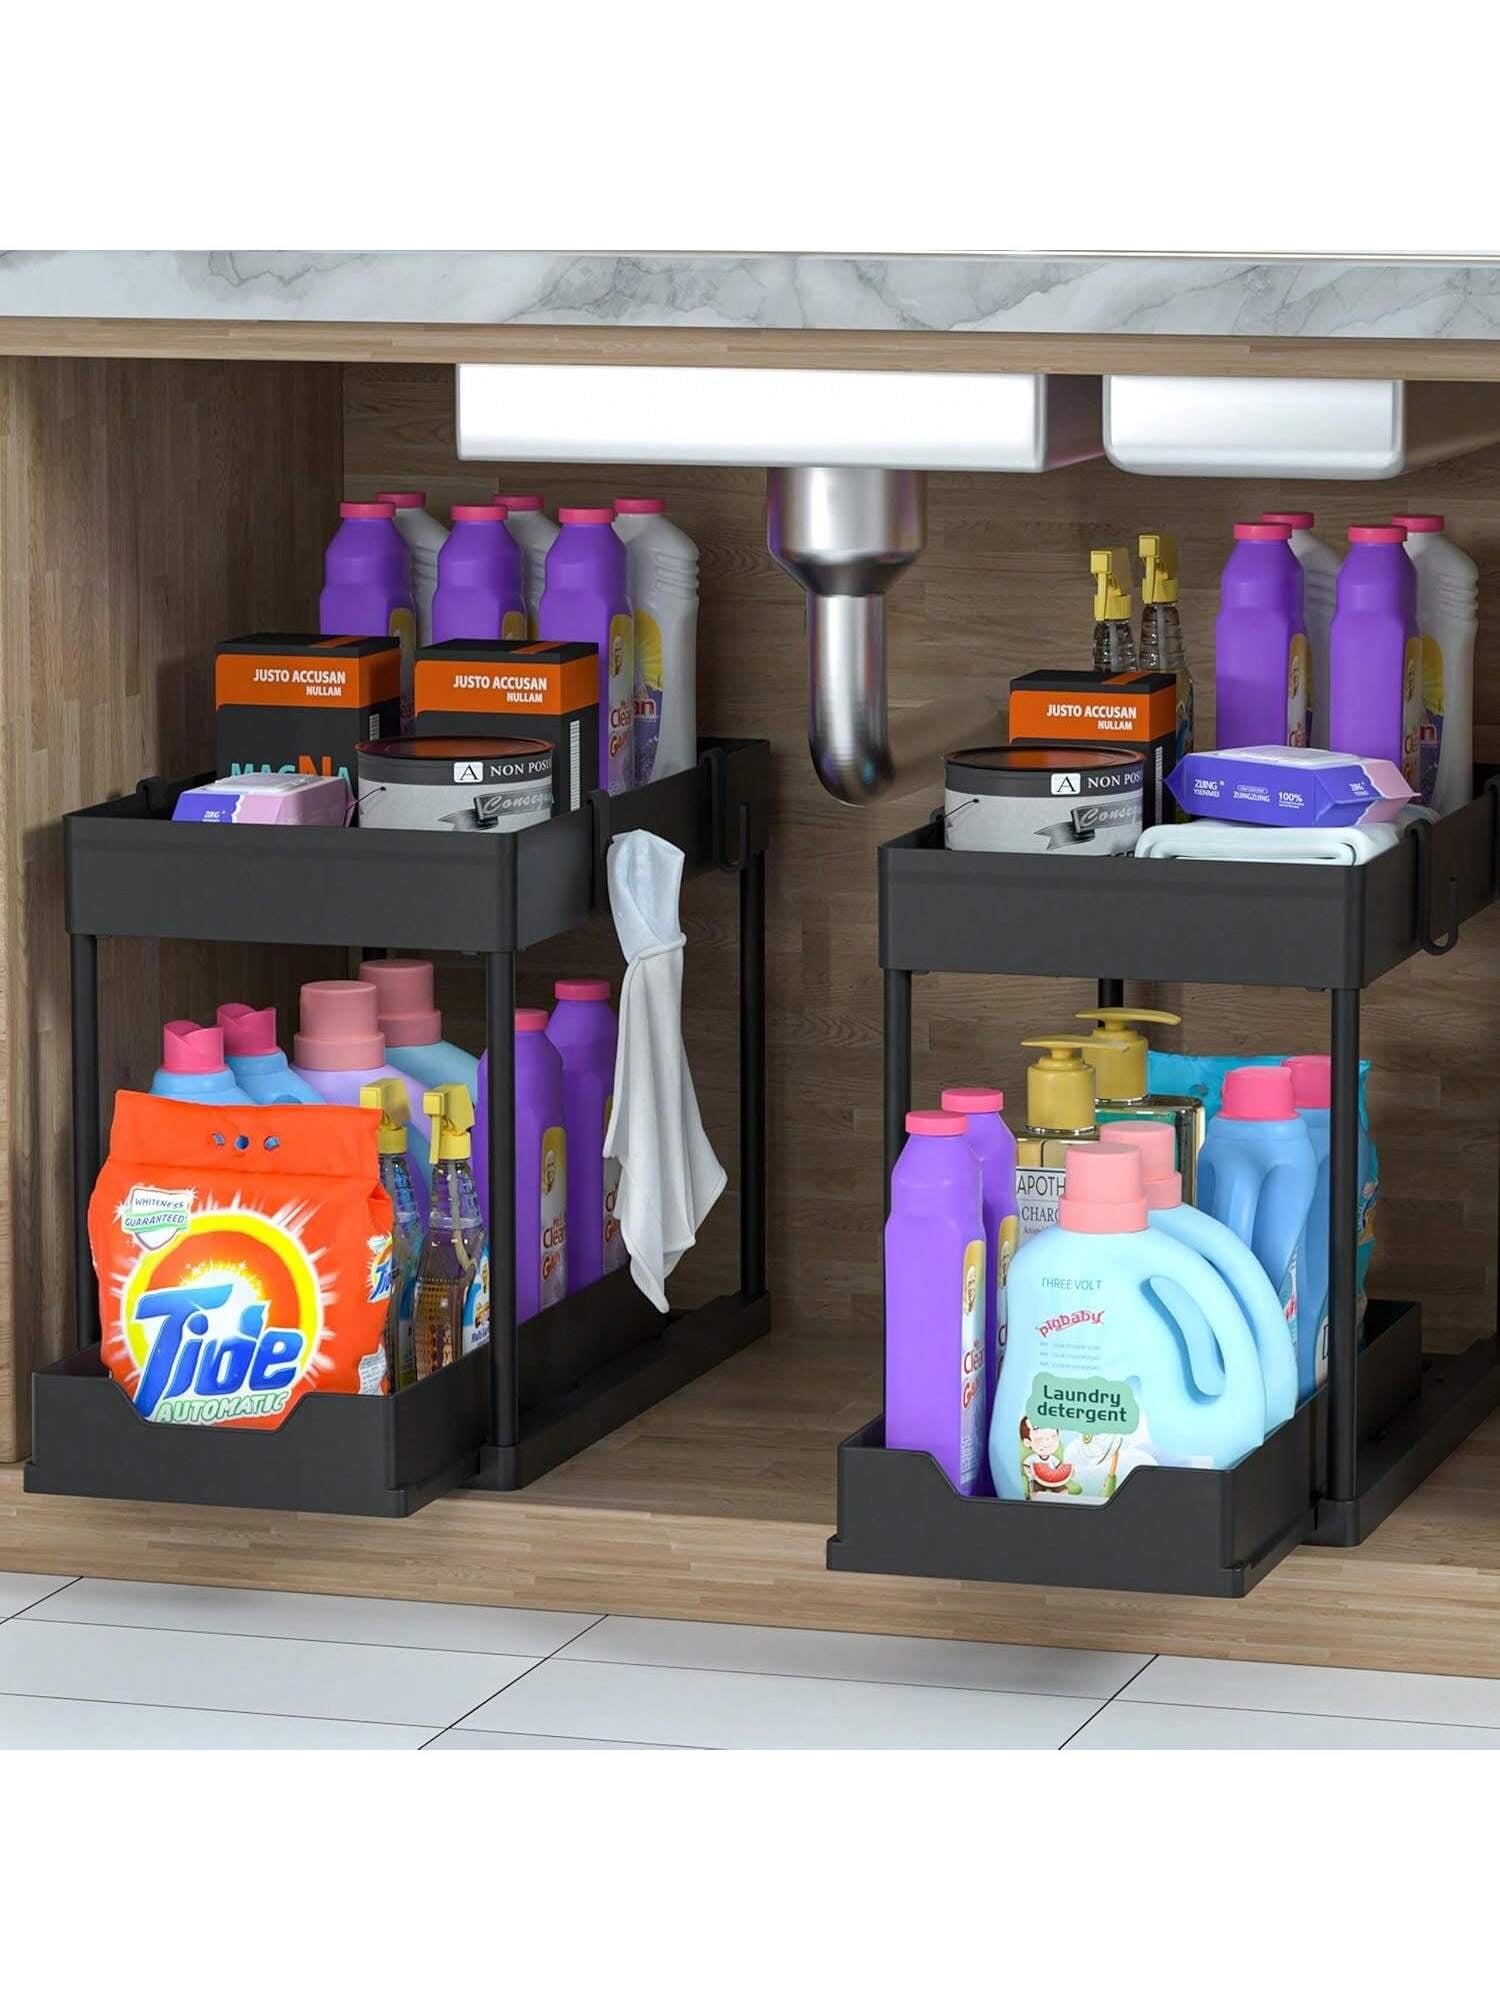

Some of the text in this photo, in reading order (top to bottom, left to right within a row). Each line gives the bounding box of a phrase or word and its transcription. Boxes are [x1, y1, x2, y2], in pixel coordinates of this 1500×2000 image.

[253, 669, 346, 684] JUSTO ACCUSAN
[453, 675, 547, 690] JUSTO ACCUSAN
[306, 685, 342, 696] NULLAM
[506, 692, 543, 702] NULLAM
[1046, 704, 1137, 719] JUSTO ACCUSAN
[1097, 720, 1133, 730] NULLAM
[460, 764, 479, 780] A
[490, 764, 524, 776] NON
[1056, 776, 1076, 792] A
[1087, 776, 1120, 788] NON
[1278, 792, 1303, 803] 100%
[135, 1198, 185, 1209] WHITENESS
[125, 1214, 185, 1226] GUARANTEED
[1042, 1277, 1073, 1290] THREE
[135, 1284, 304, 1418] Tide
[1043, 1385, 1121, 1407] Laundry
[155, 1391, 290, 1424] AUTOMATIC
[1037, 1402, 1127, 1423] detergent
